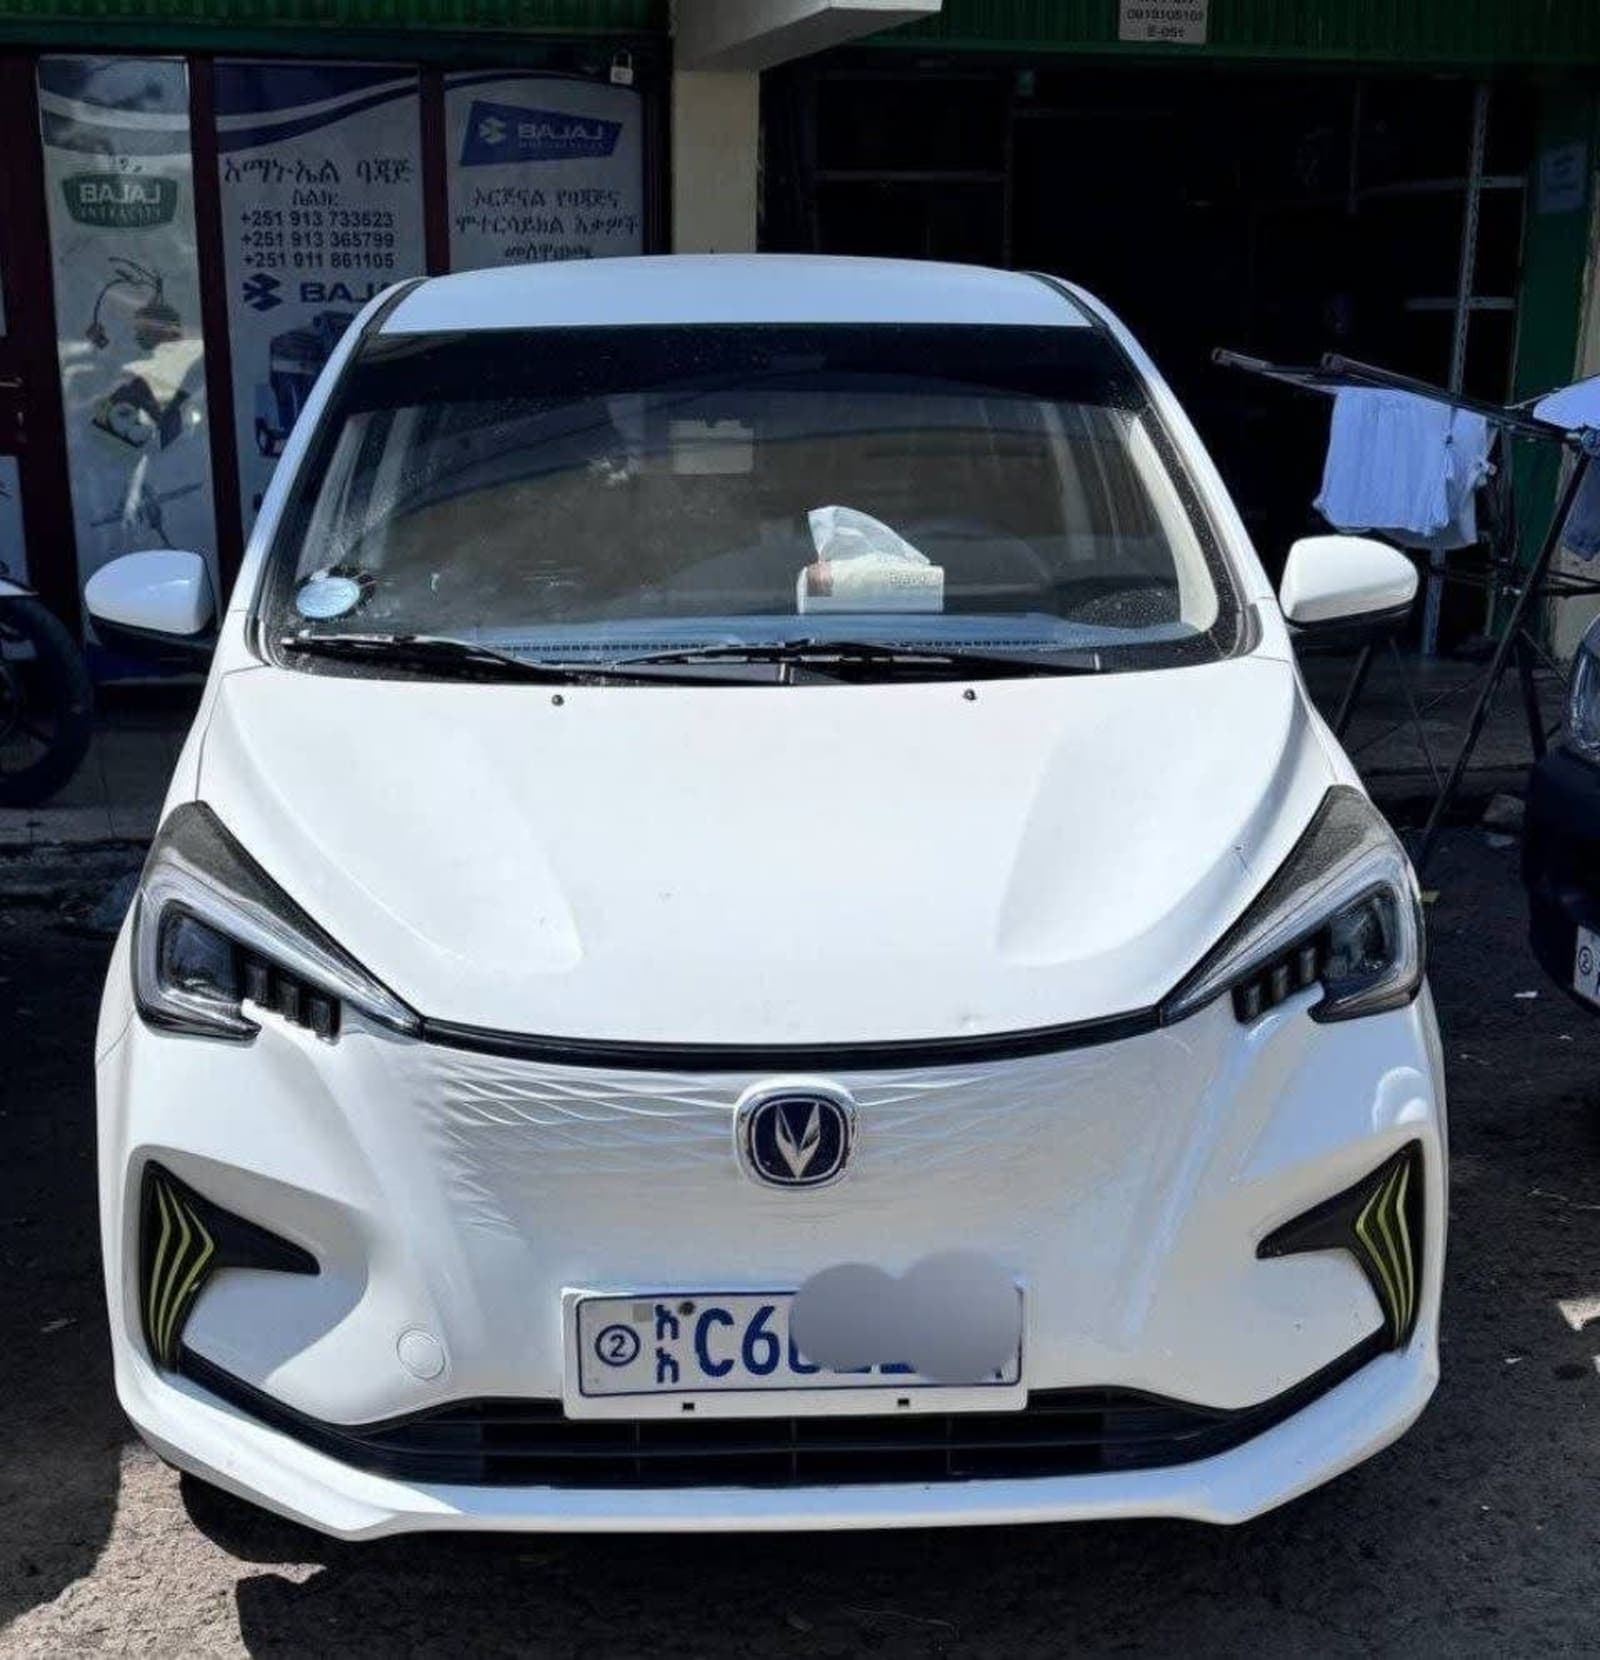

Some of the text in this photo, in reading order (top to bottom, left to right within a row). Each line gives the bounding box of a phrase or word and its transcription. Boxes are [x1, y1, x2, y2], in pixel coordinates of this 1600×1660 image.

[517, 121, 605, 140] BAJAJ
[79, 183, 161, 204] BAJAJ
[240, 210, 283, 227] +251
[289, 210, 323, 227] 913
[240, 230, 395, 248] +251 913 365799
[242, 251, 286, 268] +251
